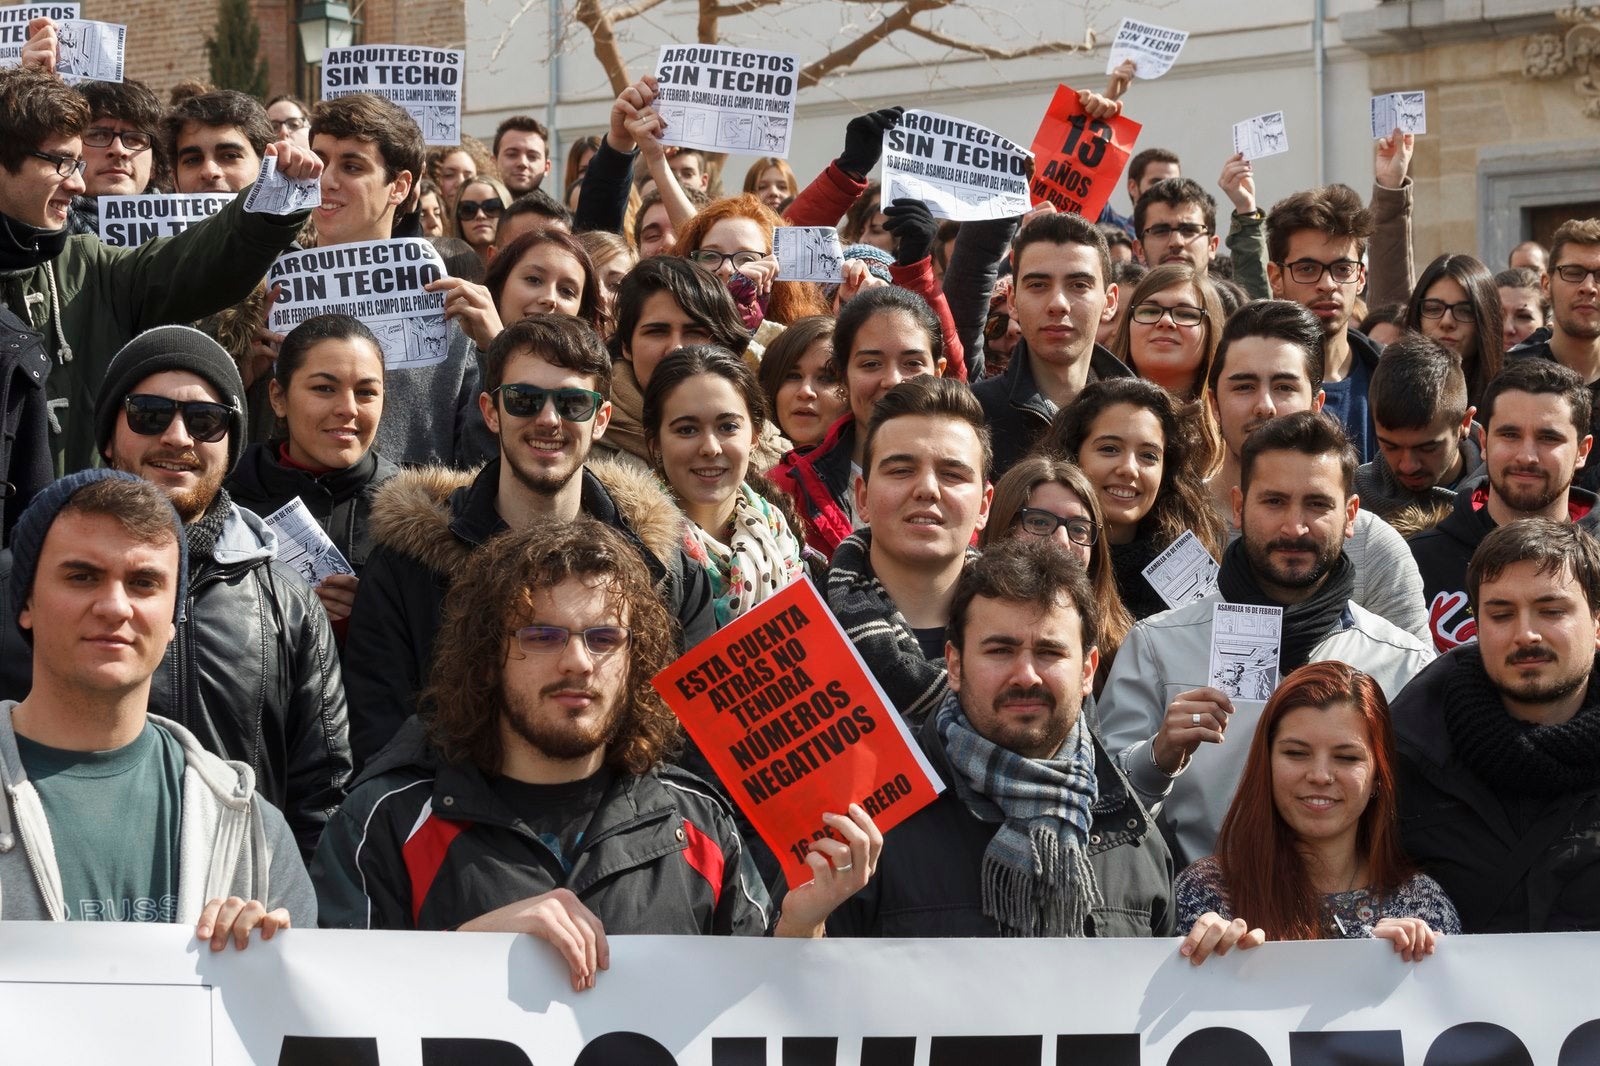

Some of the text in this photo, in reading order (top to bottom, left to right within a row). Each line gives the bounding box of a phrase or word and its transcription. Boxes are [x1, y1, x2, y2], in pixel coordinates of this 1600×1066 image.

[1118, 31, 1141, 42] SIN
[1142, 37, 1181, 53] TECHO
[1123, 21, 1186, 42] ARQUITECTOS
[327, 49, 459, 65] ARQUITECTOS
[662, 48, 794, 73] ARQUITECTOS
[326, 65, 458, 87] SIN TECHO
[657, 65, 792, 96] SIN TECHO
[691, 92, 720, 106] ASAMBLEA
[720, 96, 727, 107] EN
[728, 97, 734, 108] EL
[734, 96, 754, 109] CAMPO
[754, 99, 763, 110] DEL
[888, 130, 1027, 177] SIN TECHO
[1061, 114, 1113, 168] 13
[887, 155, 893, 167] 16
[893, 157, 900, 170] DE
[925, 163, 954, 181] ASAMBLEA
[955, 171, 963, 183] EN
[963, 171, 969, 184] EL
[969, 172, 989, 188] CAMPO
[990, 175, 999, 190] DEL
[1042, 158, 1093, 198] AÑOS
[106, 198, 230, 219] ARQUITECT
[1032, 179, 1082, 214] YA BASTA
[106, 222, 159, 247] SIN
[270, 243, 438, 279] ARQUITECTOS
[270, 264, 442, 304] SIN TECHO
[274, 310, 282, 326] 16
[282, 308, 291, 325] DE
[358, 301, 366, 317] EN
[367, 300, 374, 316] EL
[375, 297, 400, 315] CAMPO
[400, 296, 412, 312] DEL
[413, 292, 445, 311] PRÍNCIPE
[1217, 603, 1244, 613] ASAMBLEA
[1251, 607, 1258, 615] DE
[1259, 607, 1281, 616] FEBRERO
[675, 604, 811, 701] ESTA CUENTA
[770, 637, 807, 673] NO
[728, 680, 851, 771] NÚMEROS
[741, 704, 877, 806] NEGATIVOS
[859, 773, 912, 819] RERO
